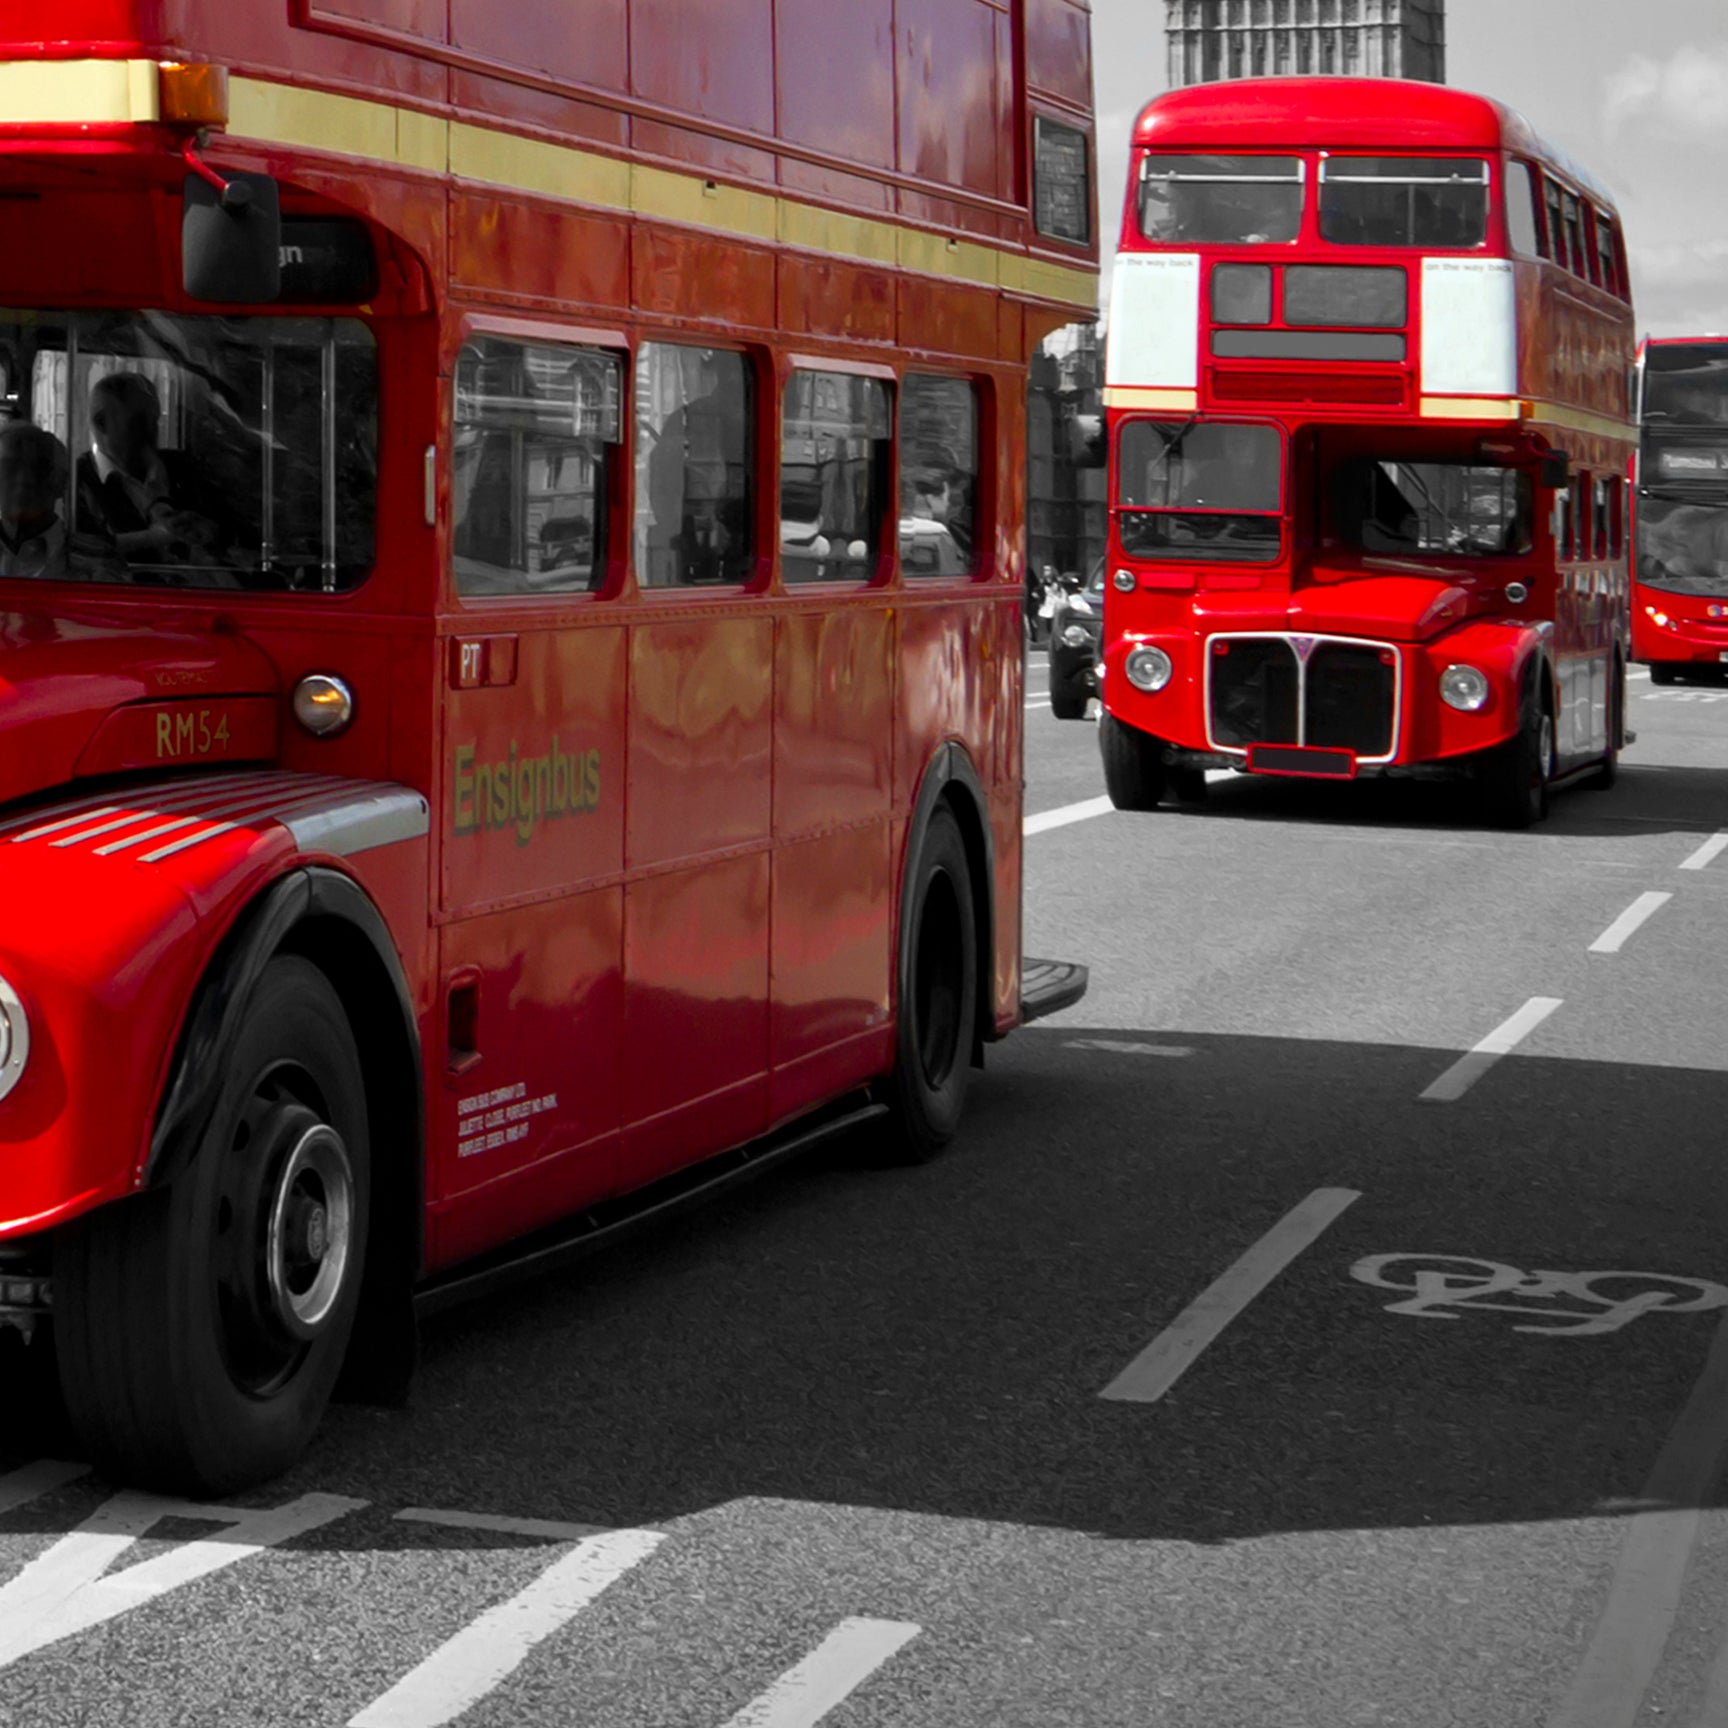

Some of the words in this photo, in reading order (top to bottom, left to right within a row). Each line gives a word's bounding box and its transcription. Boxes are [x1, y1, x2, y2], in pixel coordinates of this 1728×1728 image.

[461, 643, 481, 679] PT
[157, 710, 231, 758] RM54
[453, 734, 601, 847] Ensignbus
